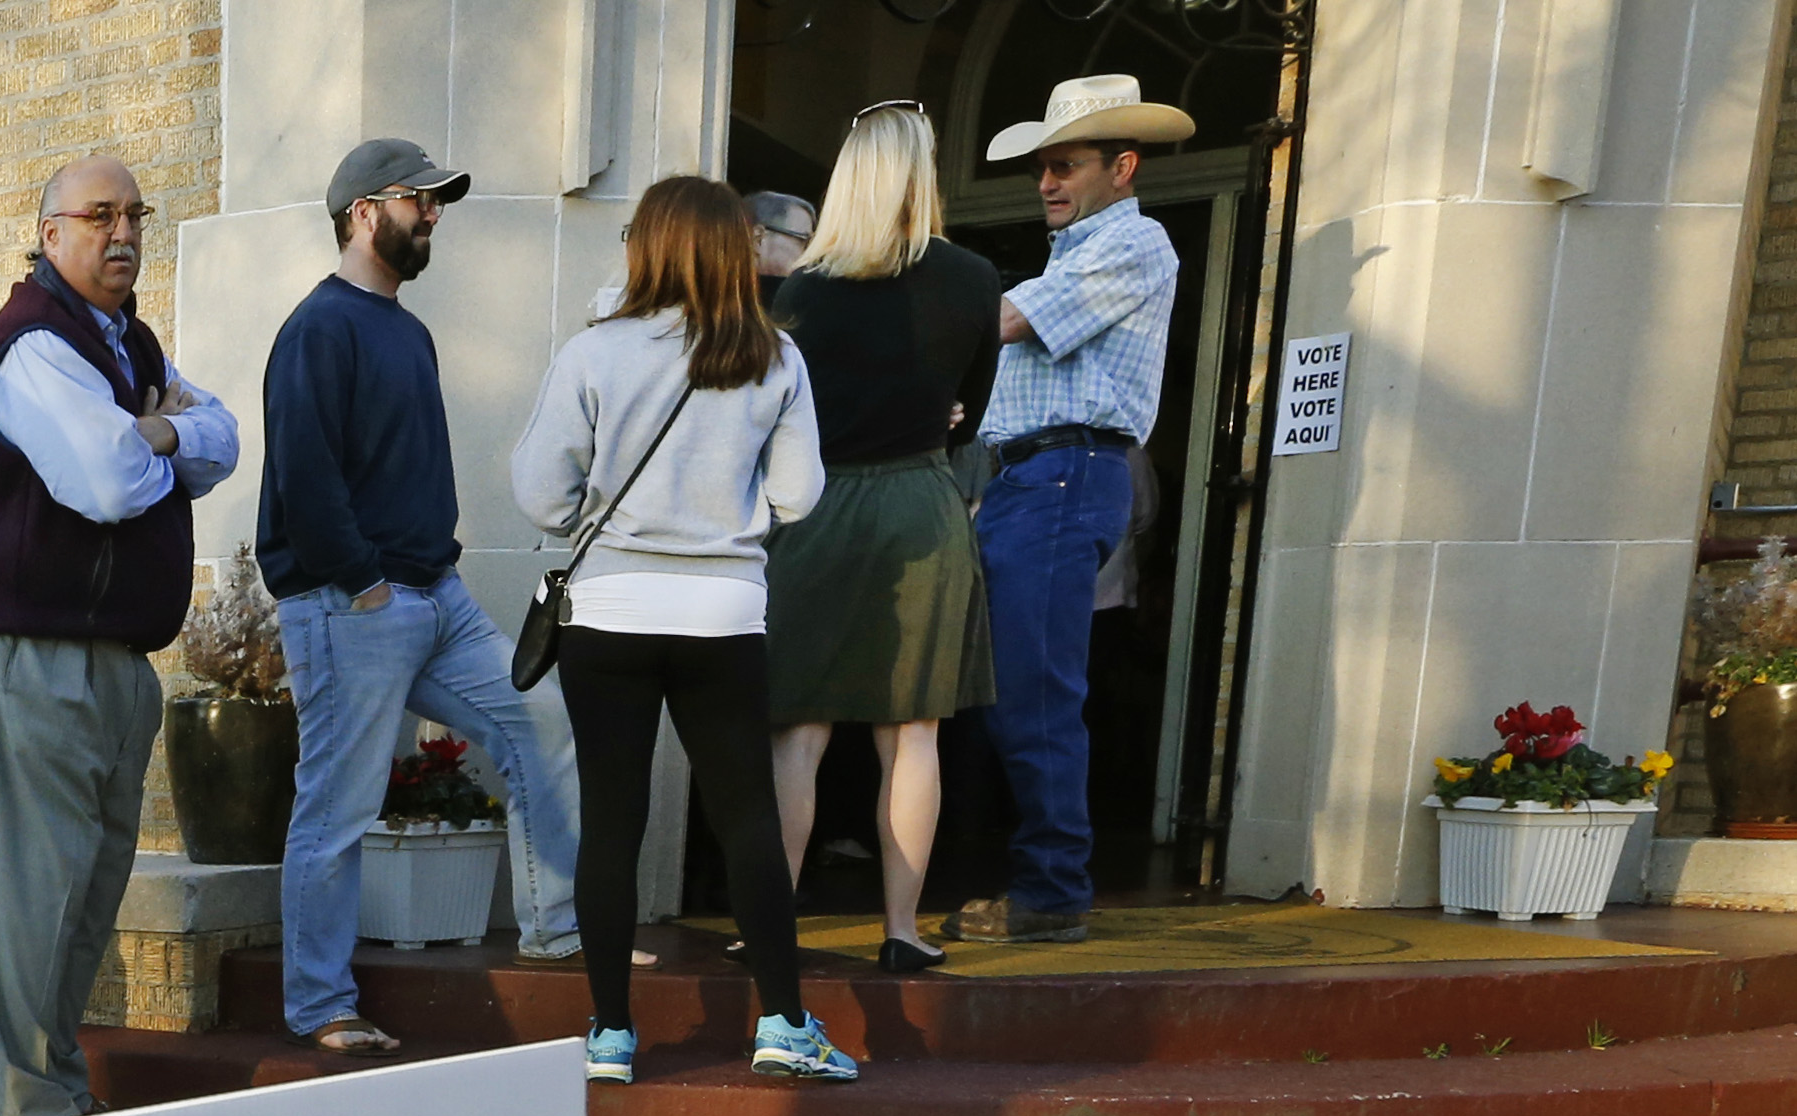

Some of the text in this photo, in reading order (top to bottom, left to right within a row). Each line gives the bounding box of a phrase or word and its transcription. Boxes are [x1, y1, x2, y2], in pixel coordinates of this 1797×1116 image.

[1297, 344, 1342, 366] VOTE
[1292, 371, 1339, 392] HERE
[1290, 397, 1336, 418] VOTE
